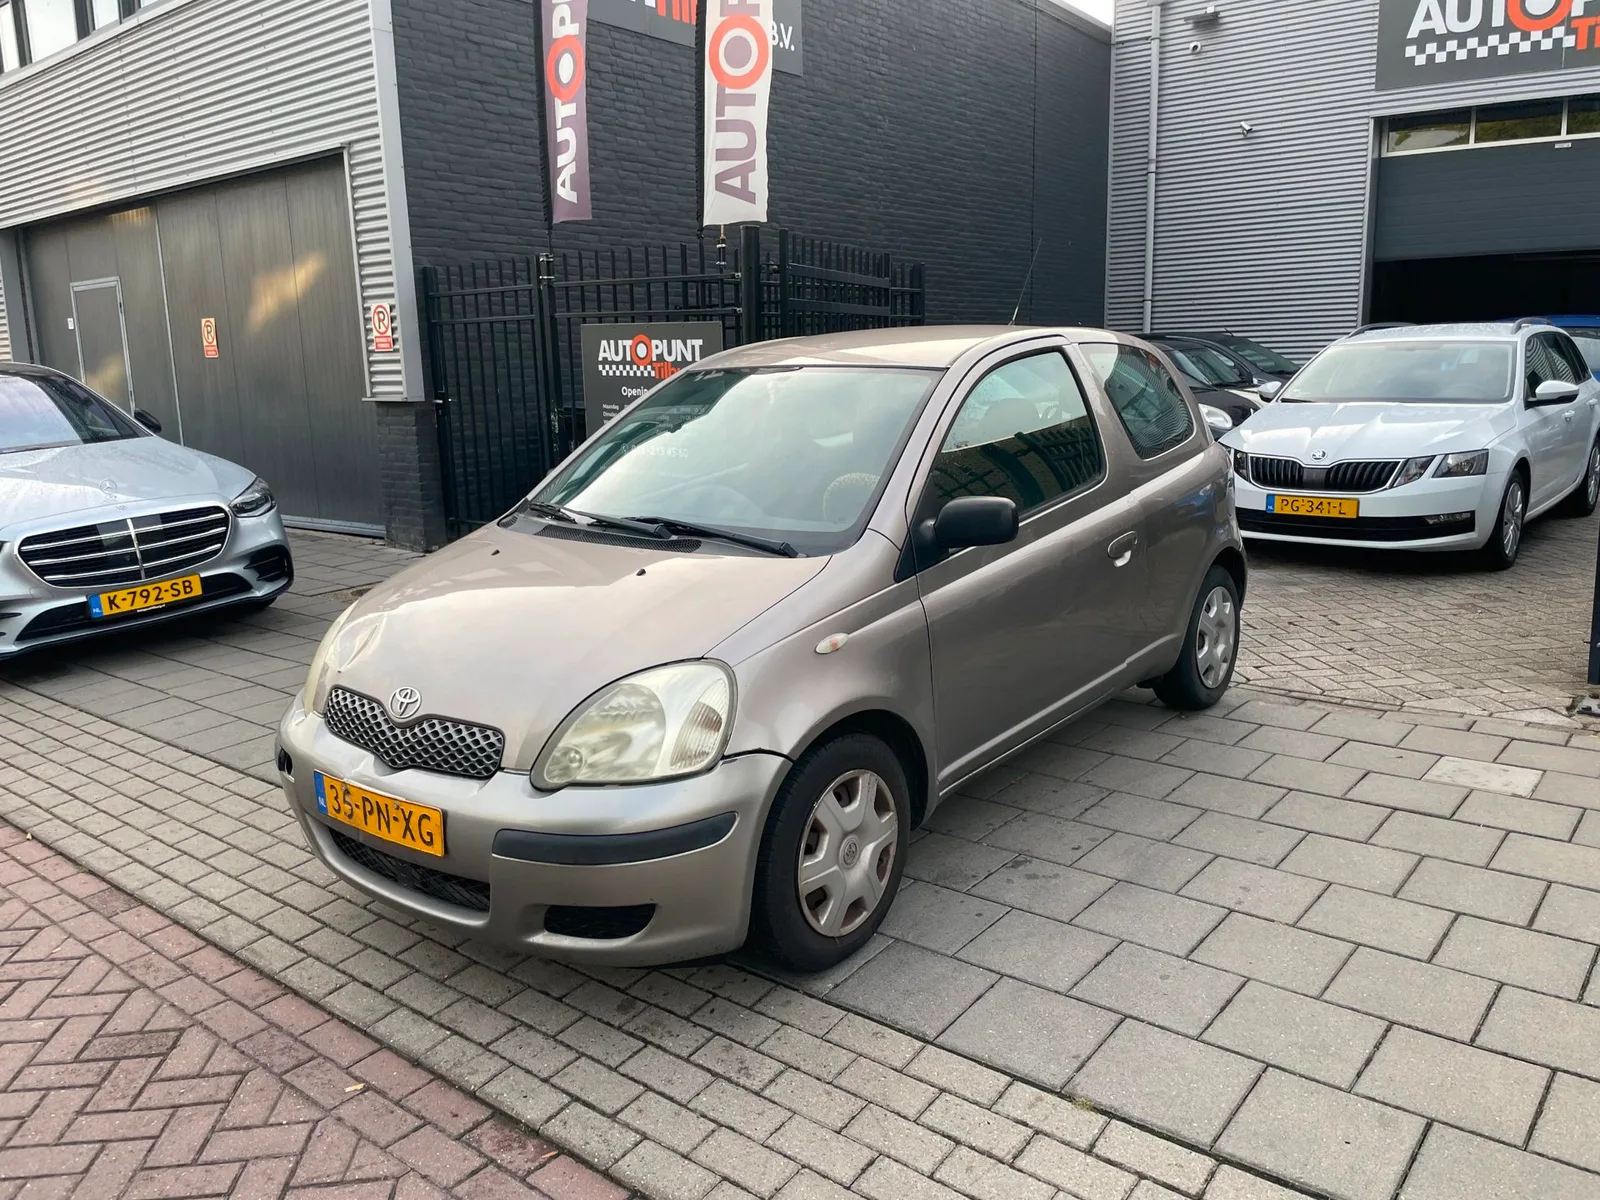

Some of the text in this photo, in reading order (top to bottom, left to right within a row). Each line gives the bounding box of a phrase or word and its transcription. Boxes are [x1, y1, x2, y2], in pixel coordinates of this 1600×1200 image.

[546, 0, 584, 204] AUTOP
[598, 334, 703, 366] AUTOPUNT
[652, 361, 680, 379] Tilb
[1280, 498, 1347, 515] PG-341-L
[107, 579, 193, 611] K-792-SB
[318, 796, 326, 808] NL
[329, 784, 434, 847] 35-PN-XG
